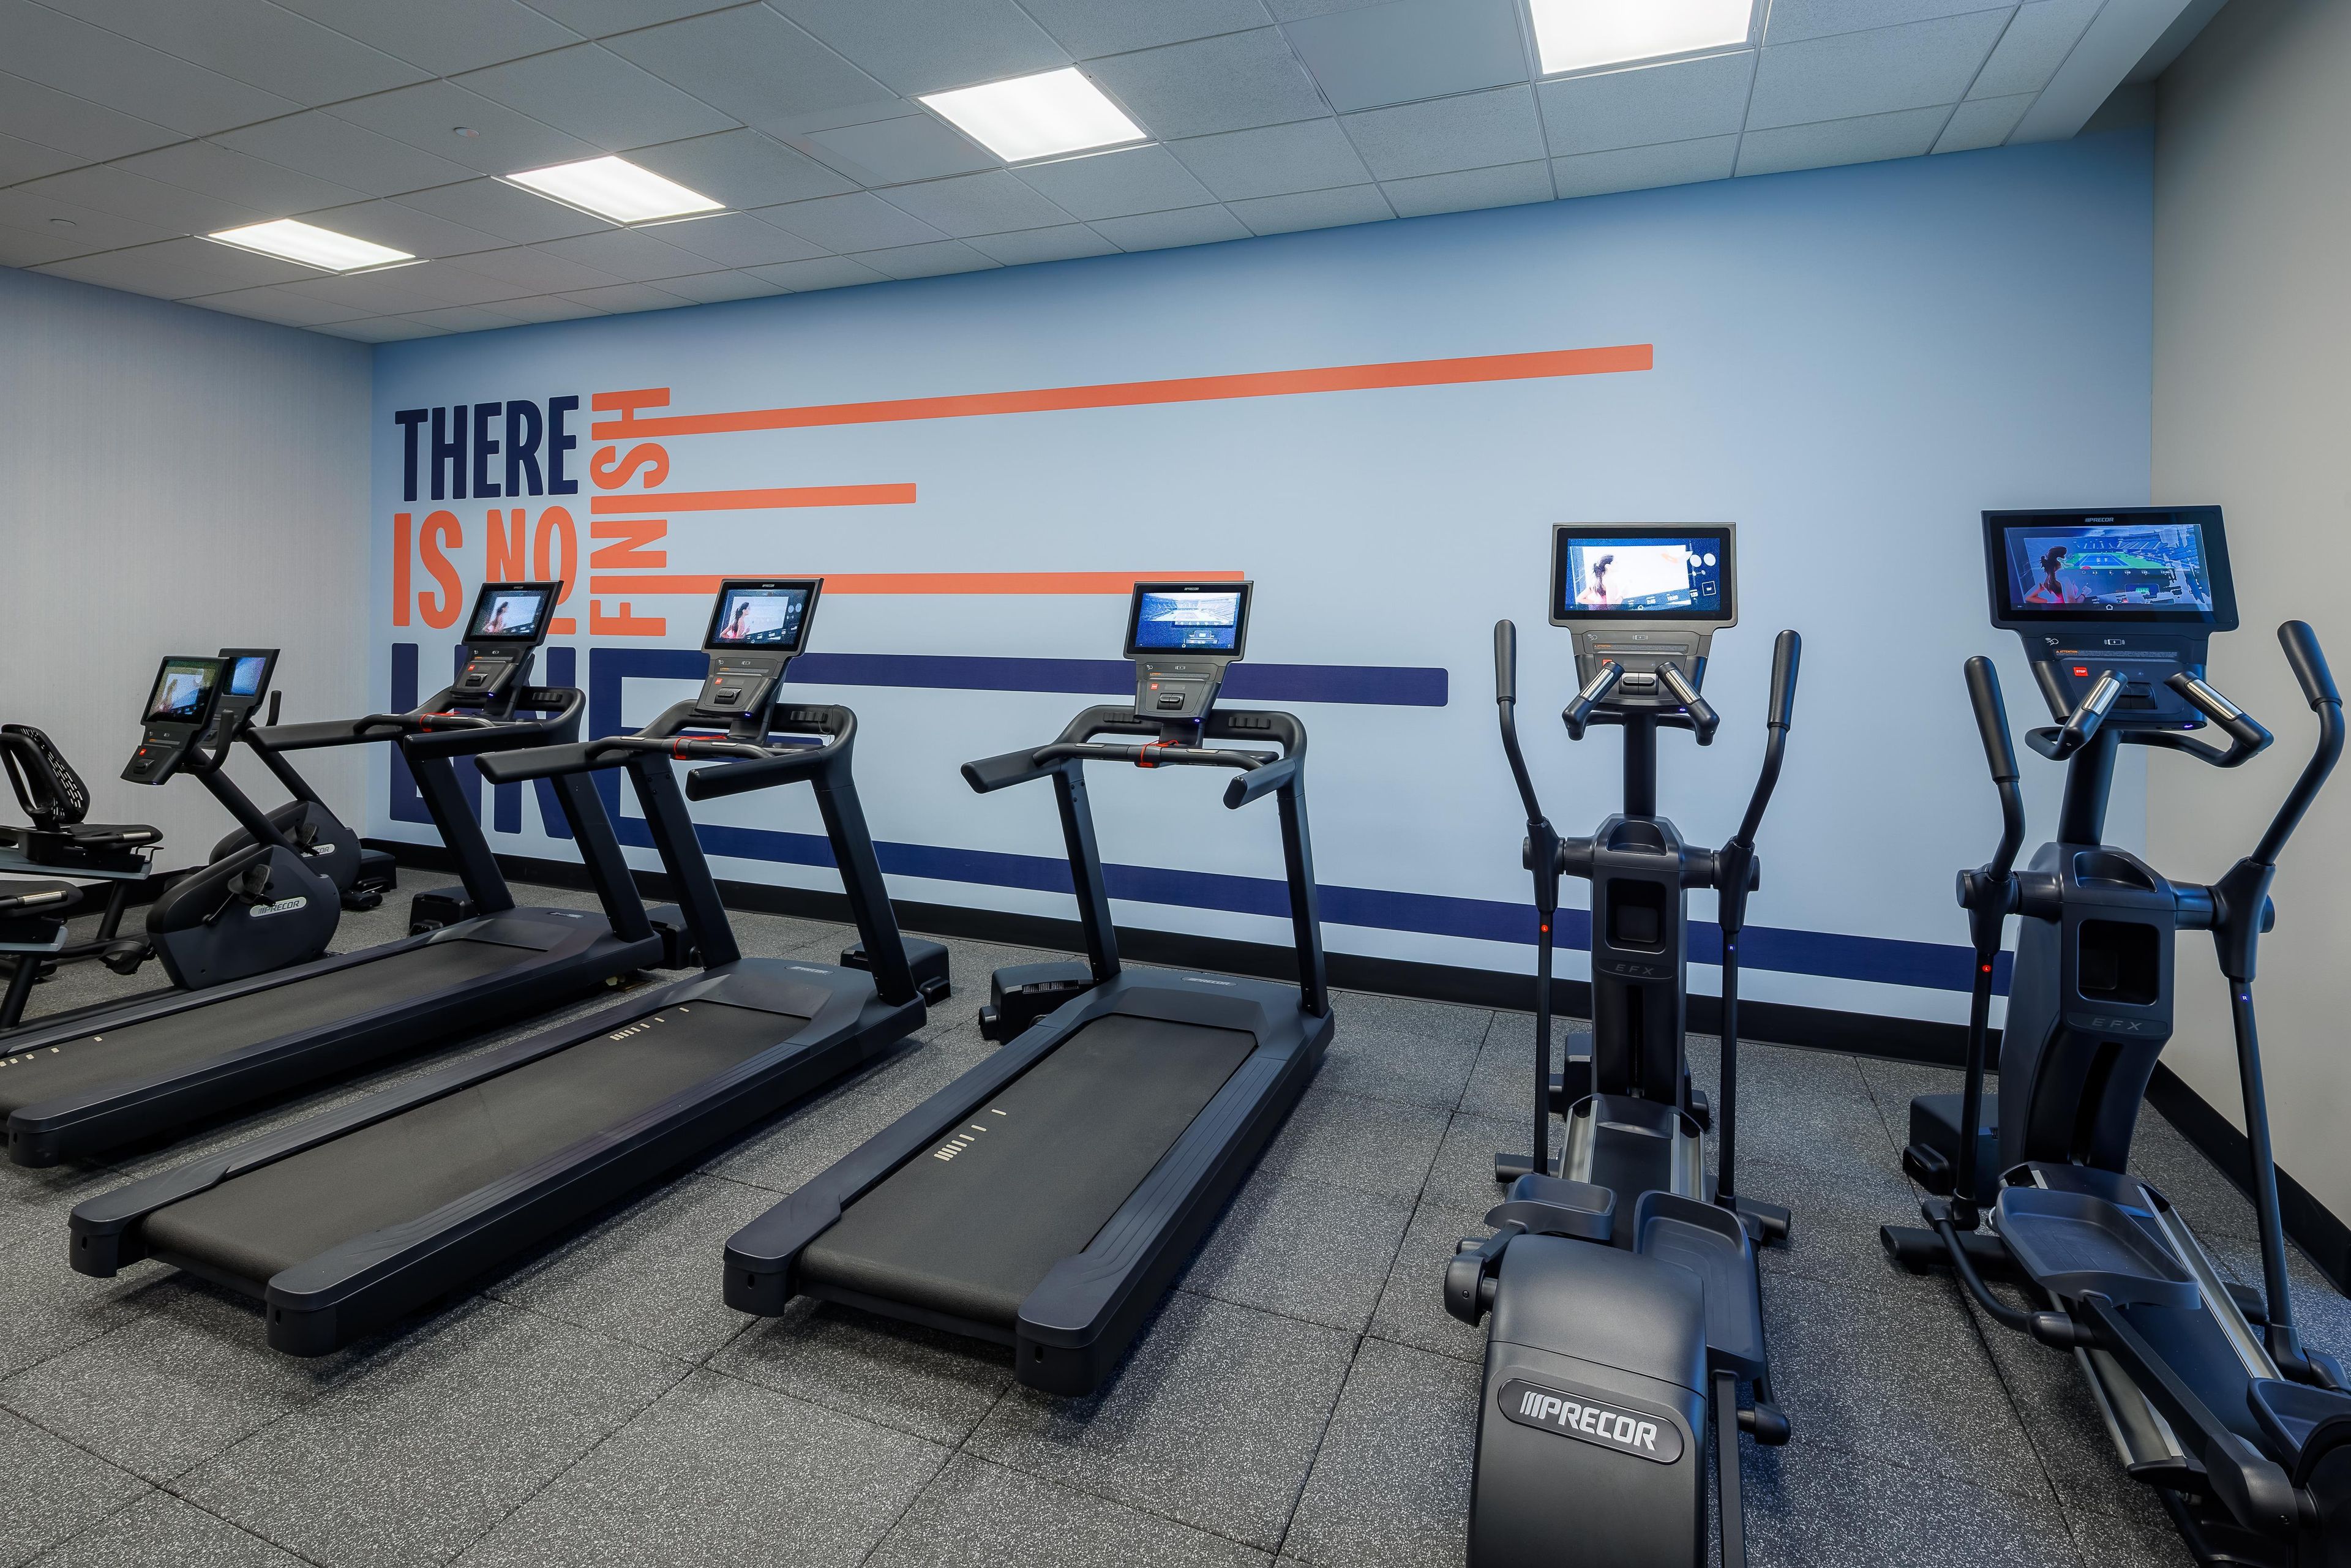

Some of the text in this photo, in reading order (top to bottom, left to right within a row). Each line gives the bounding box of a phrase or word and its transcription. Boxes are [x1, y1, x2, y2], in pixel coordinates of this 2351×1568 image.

[395, 395, 579, 502] THERE
[590, 388, 670, 636] FINISH
[392, 506, 578, 629] IS NO
[263, 900, 300, 914] PRECOR
[1615, 964, 1655, 975] EFX
[2092, 1017, 2143, 1030] EFX
[1538, 1395, 1658, 1450] PRECOR
